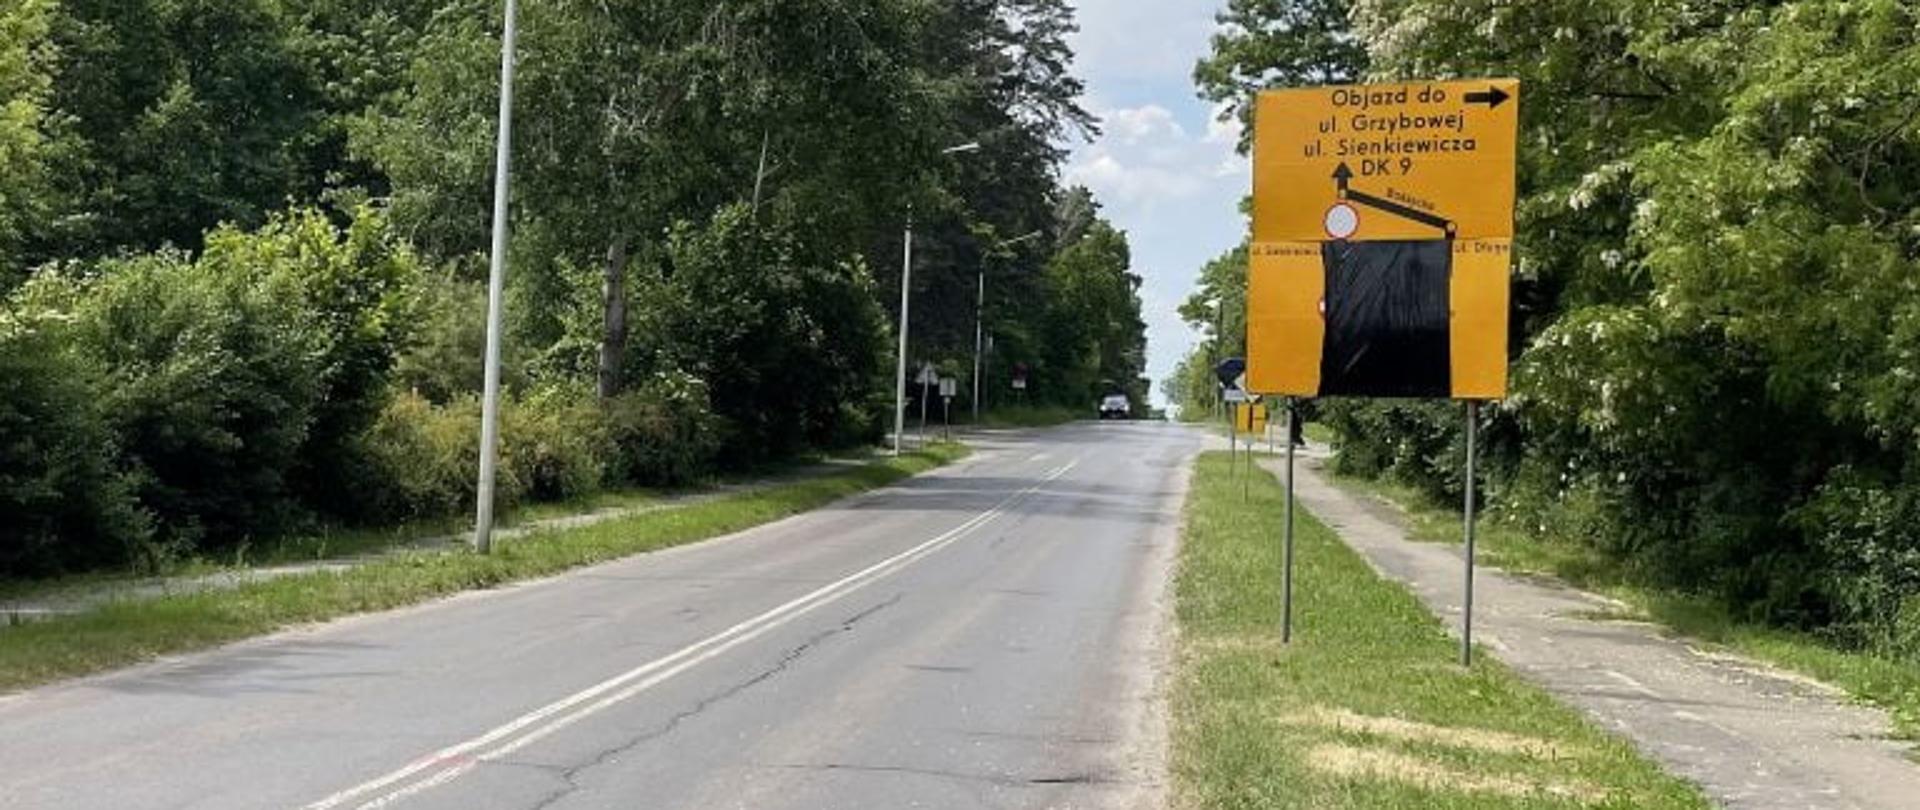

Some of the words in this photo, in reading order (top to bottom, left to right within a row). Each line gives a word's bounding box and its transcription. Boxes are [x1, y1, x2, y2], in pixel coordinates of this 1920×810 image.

[1331, 87, 1408, 110] Objazd
[1417, 85, 1446, 102] do
[1319, 116, 1340, 133] ul.
[1351, 110, 1465, 132] Grzybowej
[1304, 139, 1327, 157] ul.
[1336, 135, 1477, 156] Sienkiewicza
[1361, 159, 1390, 177] DK
[1399, 158, 1412, 176] 9
